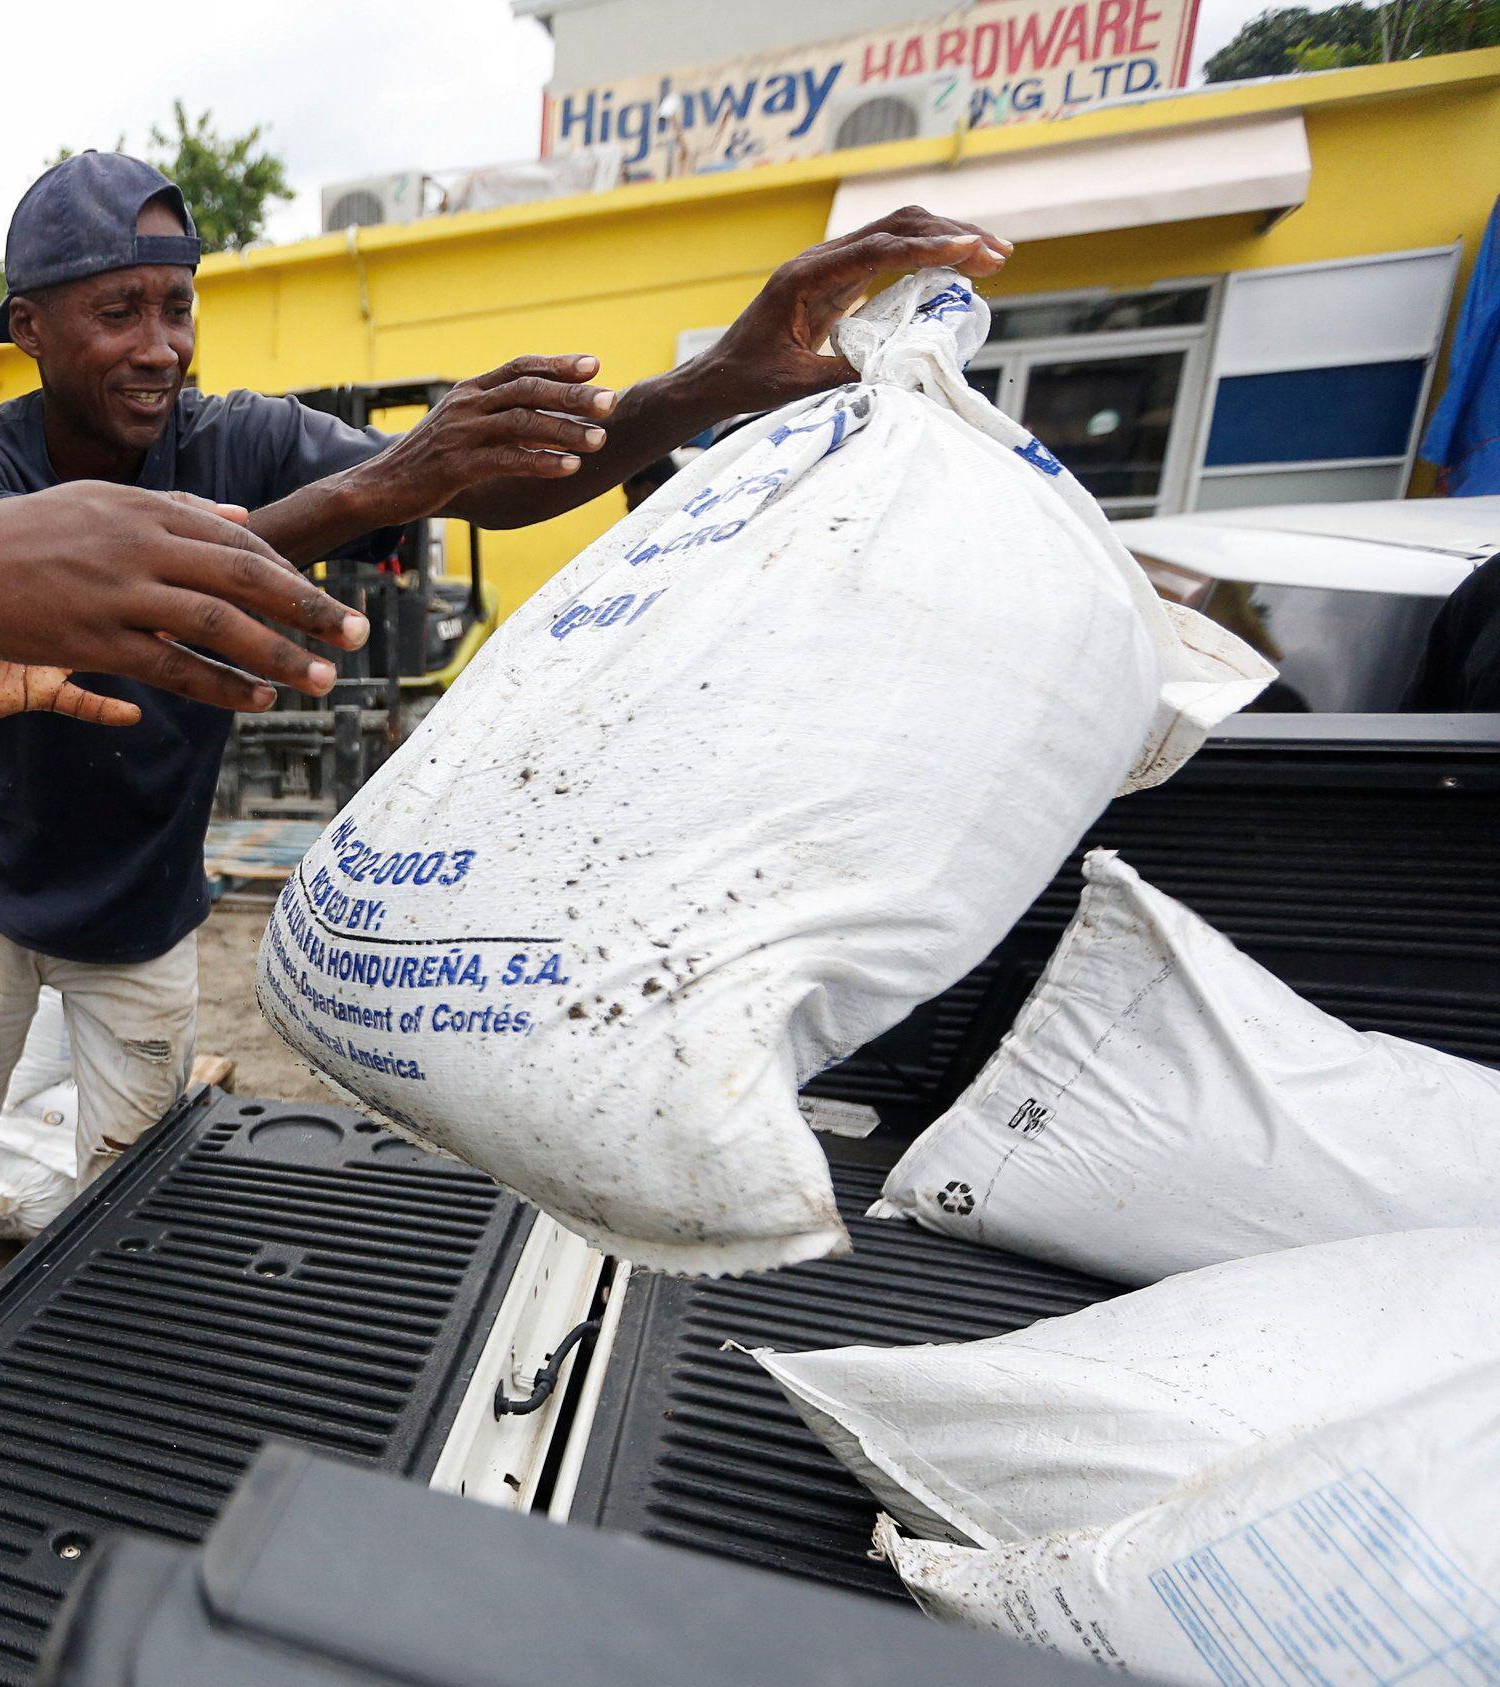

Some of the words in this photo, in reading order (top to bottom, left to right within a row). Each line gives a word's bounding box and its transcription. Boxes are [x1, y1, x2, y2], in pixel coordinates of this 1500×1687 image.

[561, 62, 844, 163] Highway
[861, 0, 1162, 84] HARDWARE
[1064, 58, 1162, 106] LTD.
[346, 898, 388, 932] BY:
[327, 947, 490, 992] HONDUREÑA,
[502, 953, 571, 987] S.A.
[399, 1004, 426, 1034] of
[431, 1002, 536, 1038] Cortés,
